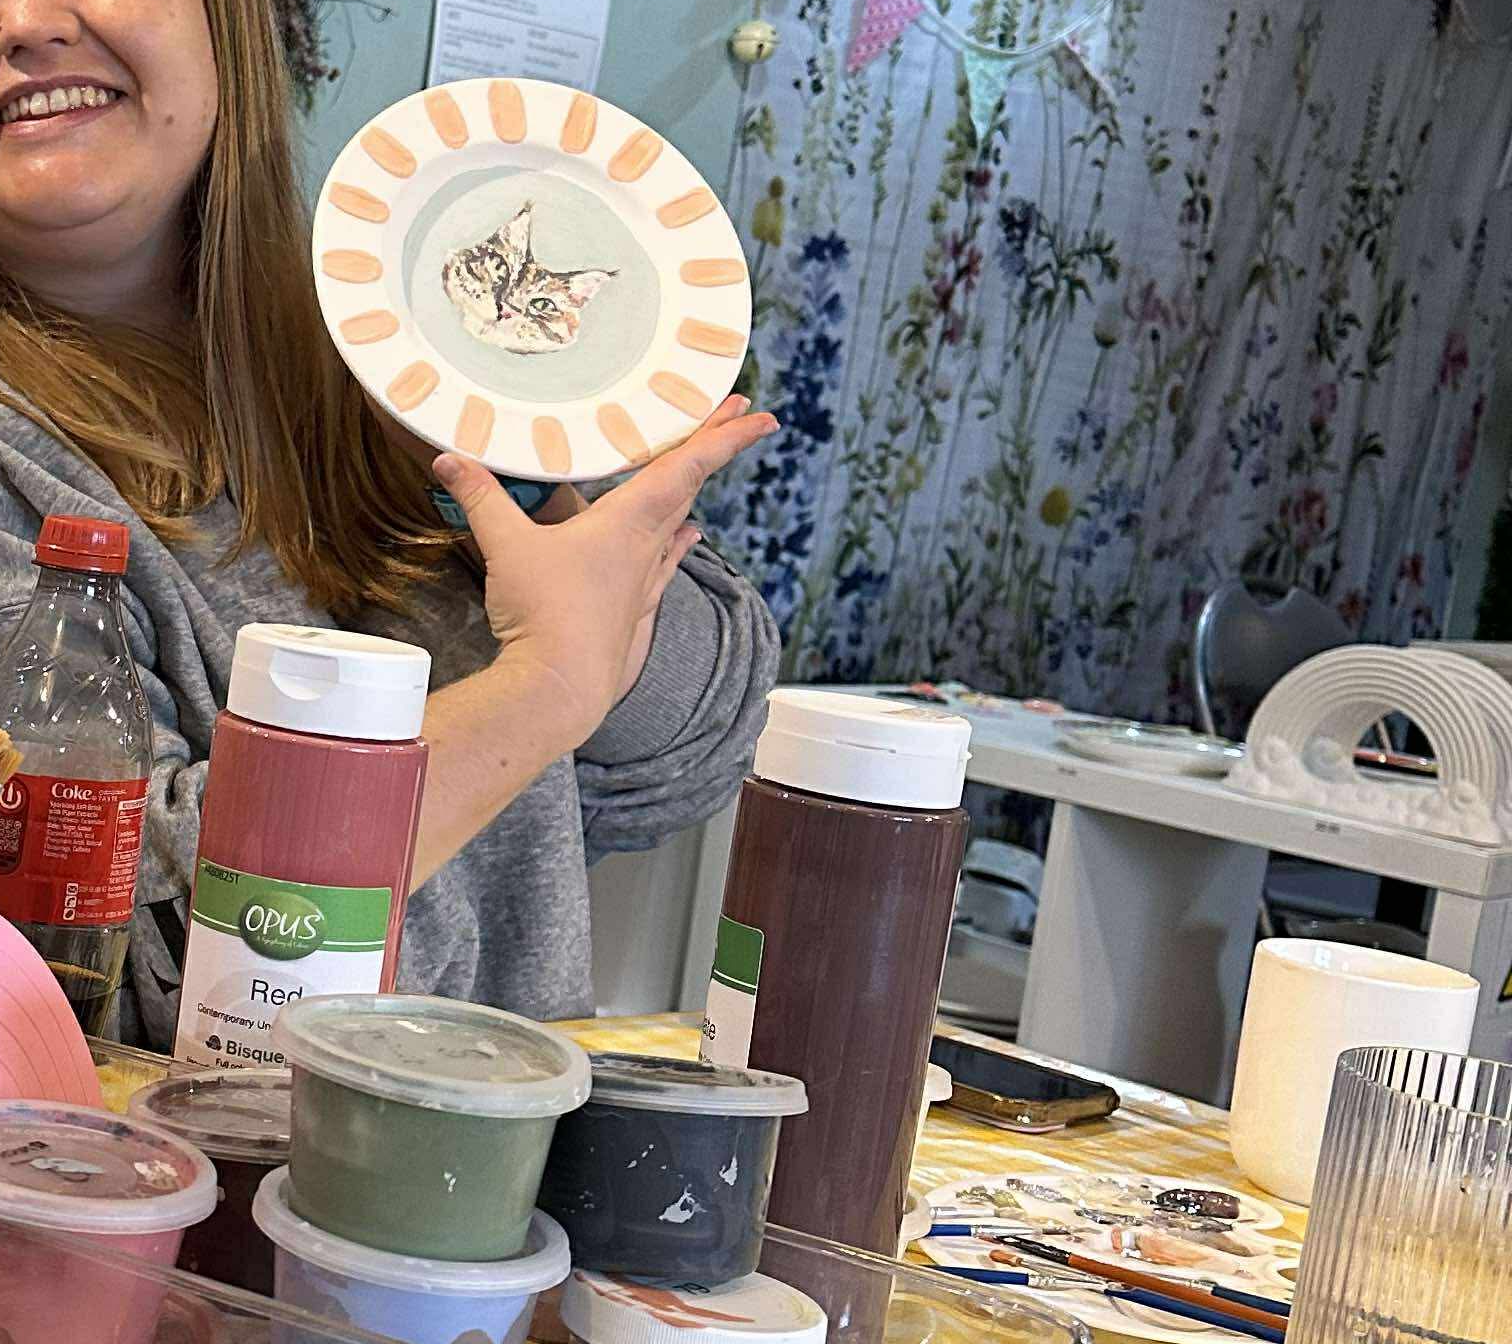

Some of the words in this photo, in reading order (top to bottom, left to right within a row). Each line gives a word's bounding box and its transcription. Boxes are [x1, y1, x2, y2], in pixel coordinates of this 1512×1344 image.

[51, 782, 93, 801] Coke
[245, 904, 324, 940] OPUS
[250, 978, 304, 1006] Red
[197, 1002, 255, 1029] Contemporary
[226, 1040, 285, 1064] Bisque
